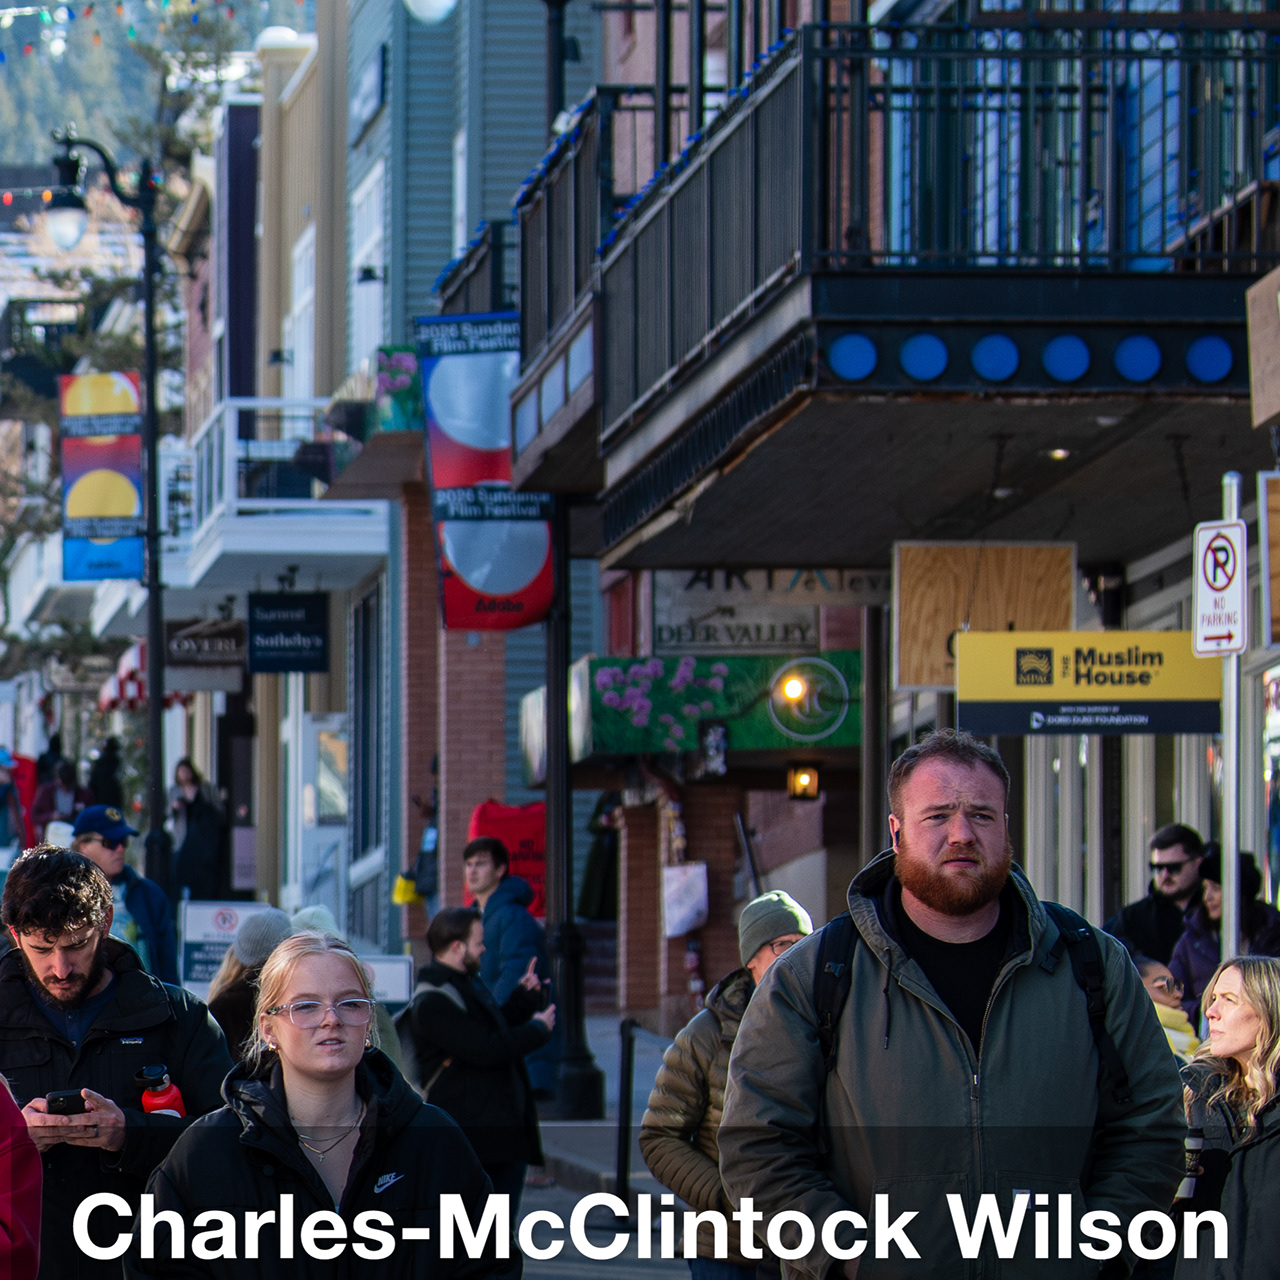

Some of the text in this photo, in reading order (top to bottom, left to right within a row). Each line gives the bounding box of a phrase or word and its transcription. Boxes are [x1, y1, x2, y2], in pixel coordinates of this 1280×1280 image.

[461, 321, 520, 336] Sundan
[433, 336, 520, 354] Film Festiv
[478, 488, 550, 502] Sundance
[449, 503, 540, 517] Film Festival
[474, 599, 525, 613] Adobe
[1214, 597, 1226, 610] NO
[1201, 611, 1238, 628] PARKING
[658, 624, 812, 642] DEER VALLEY
[255, 632, 323, 650] Sotheby's
[1074, 646, 1164, 667] Muslim
[1074, 668, 1153, 686] House
[1095, 714, 1149, 725] FOUNDATION
[378, 1172, 397, 1187] NIKE
